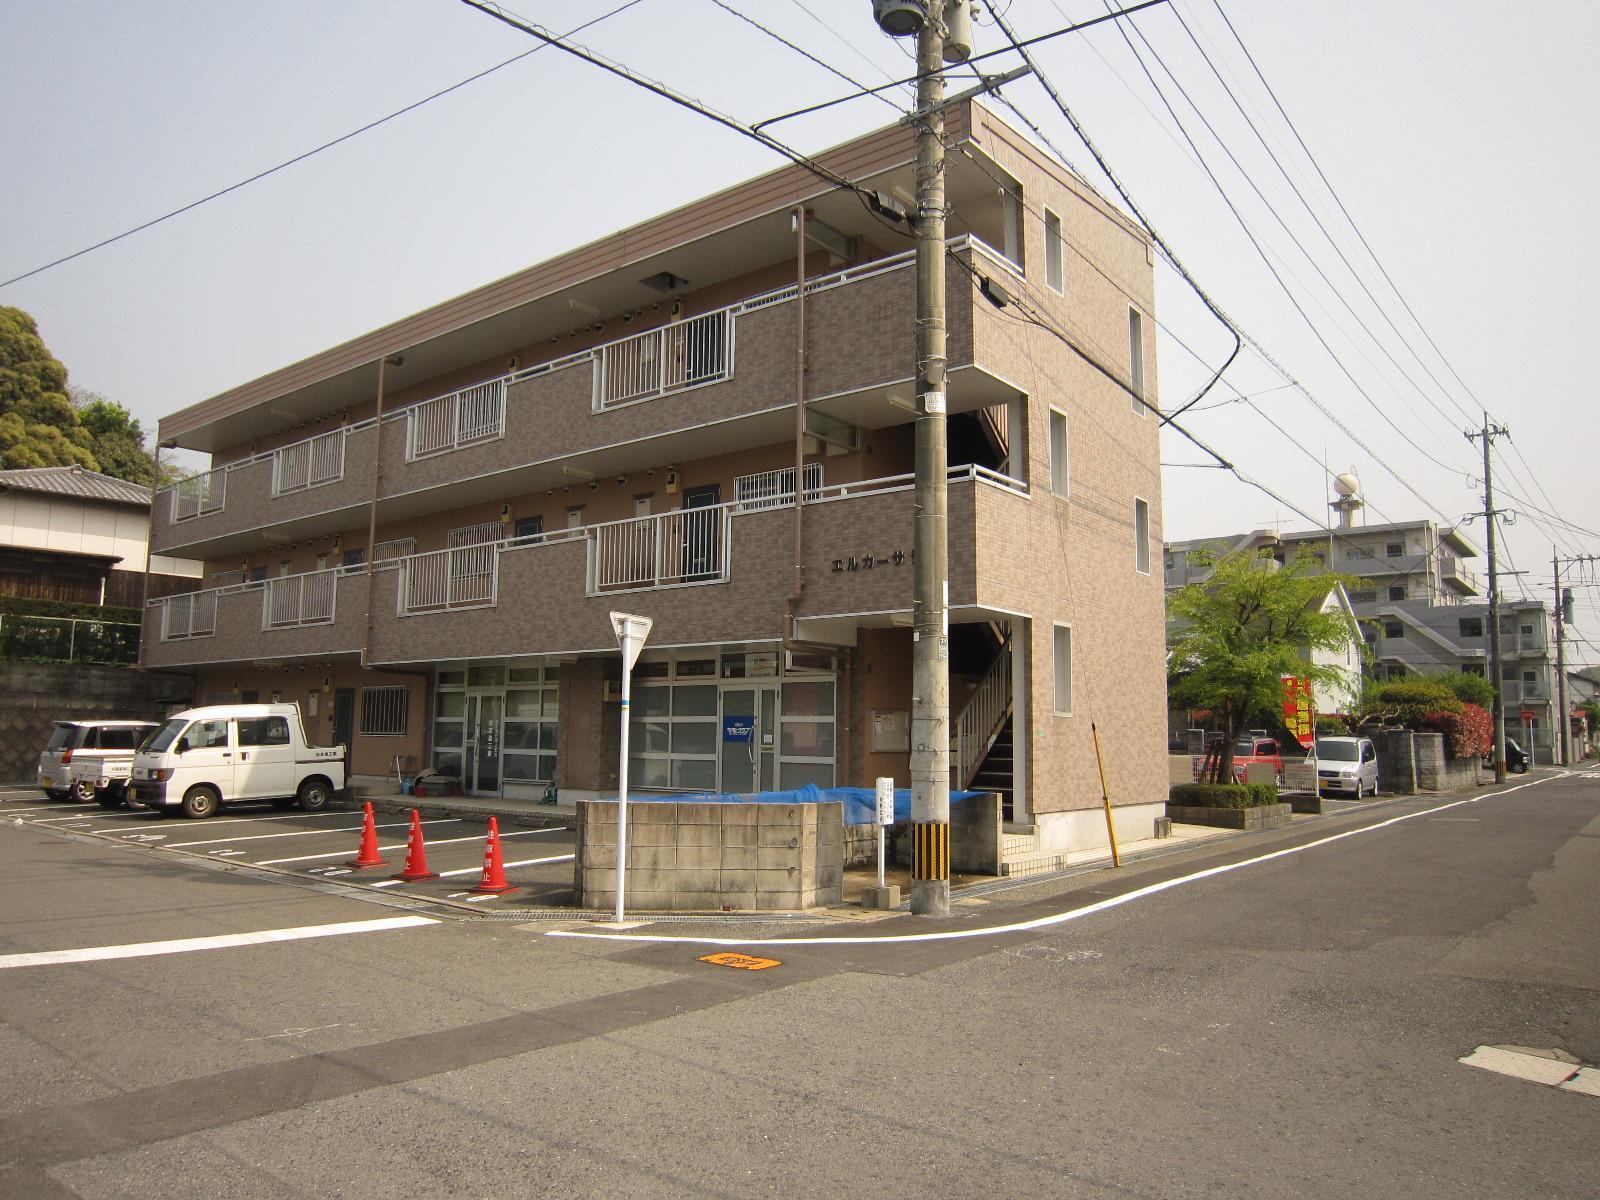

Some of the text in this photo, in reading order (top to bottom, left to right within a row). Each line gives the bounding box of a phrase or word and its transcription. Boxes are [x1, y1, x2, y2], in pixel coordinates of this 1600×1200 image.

[831, 550, 914, 572] エルカーサ
